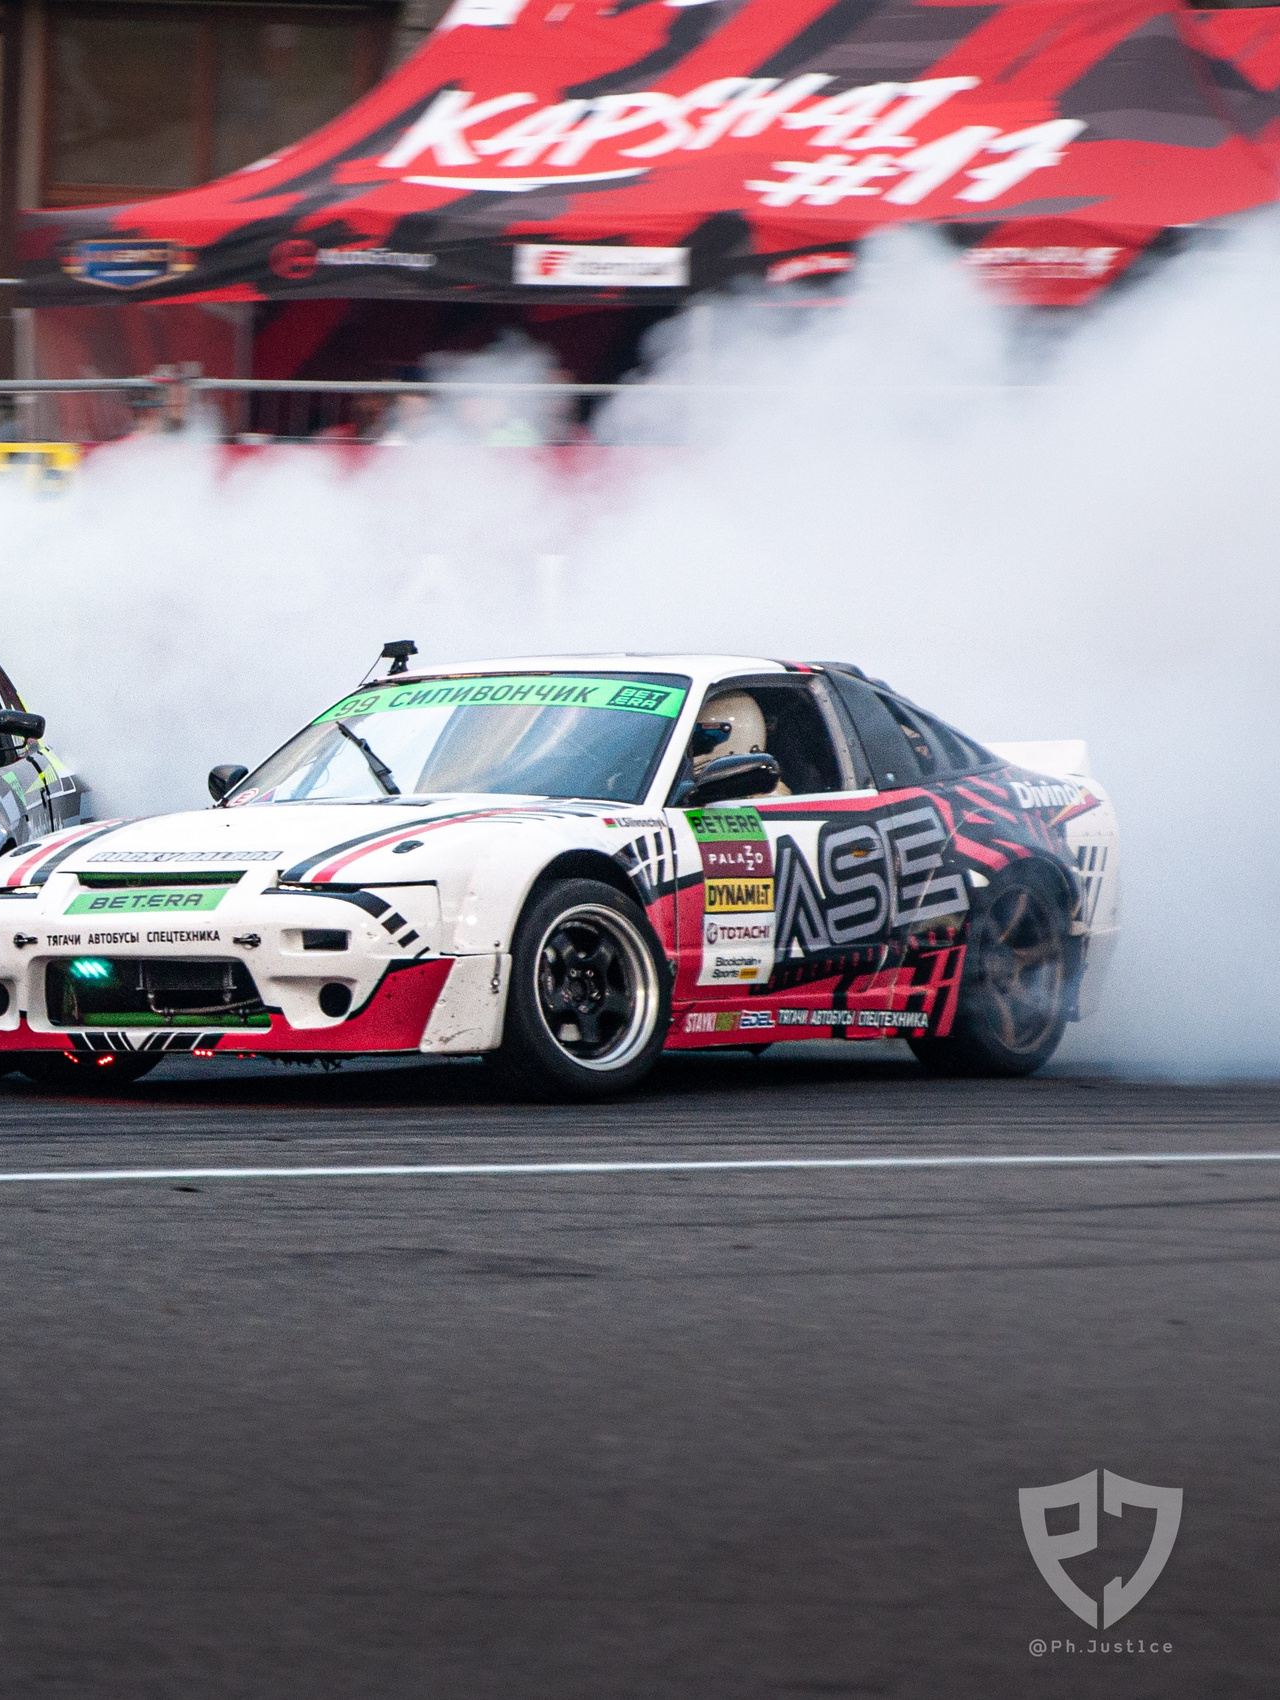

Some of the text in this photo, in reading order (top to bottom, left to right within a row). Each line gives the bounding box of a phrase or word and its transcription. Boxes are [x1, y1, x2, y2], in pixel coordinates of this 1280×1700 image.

[334, 684, 600, 717] 99 СИЛИВОНЧИК
[46, 930, 221, 947] ТЯГАЧИ АВТОБУСЫ СПЕЦТЕХНИКА
[719, 925, 770, 940] TOTACHI
[857, 1011, 929, 1028] СПЕЦТЕХНИКА
